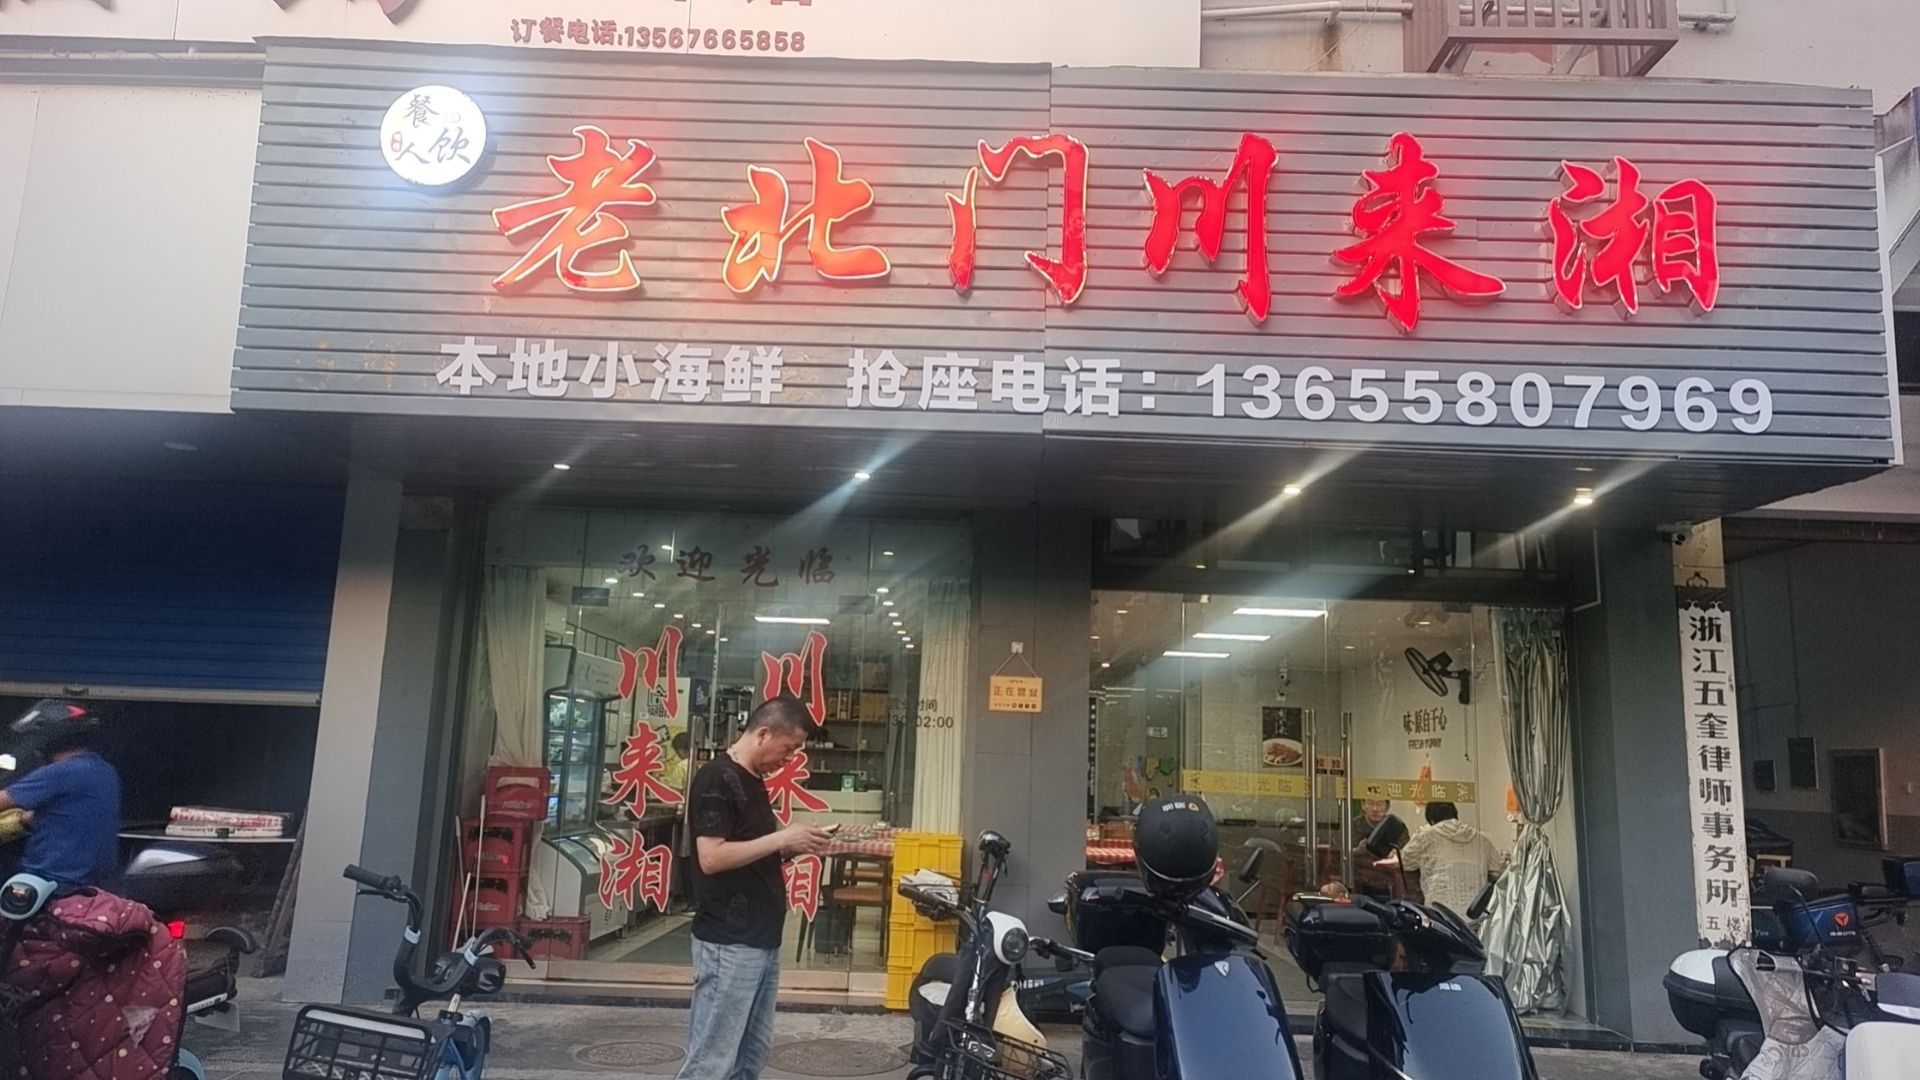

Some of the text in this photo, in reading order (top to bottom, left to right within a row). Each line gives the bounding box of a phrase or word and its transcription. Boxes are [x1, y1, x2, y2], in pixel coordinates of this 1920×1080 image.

[510, 17, 805, 52] 订餐电话:13567665858
[492, 125, 1721, 335] 老北门川来湘
[435, 336, 784, 404] 本地小海鲜
[617, 544, 836, 588] 欢迎光临
[598, 625, 685, 913] 川来湘
[1689, 615, 1742, 908] 浙江五奎律师事务所
